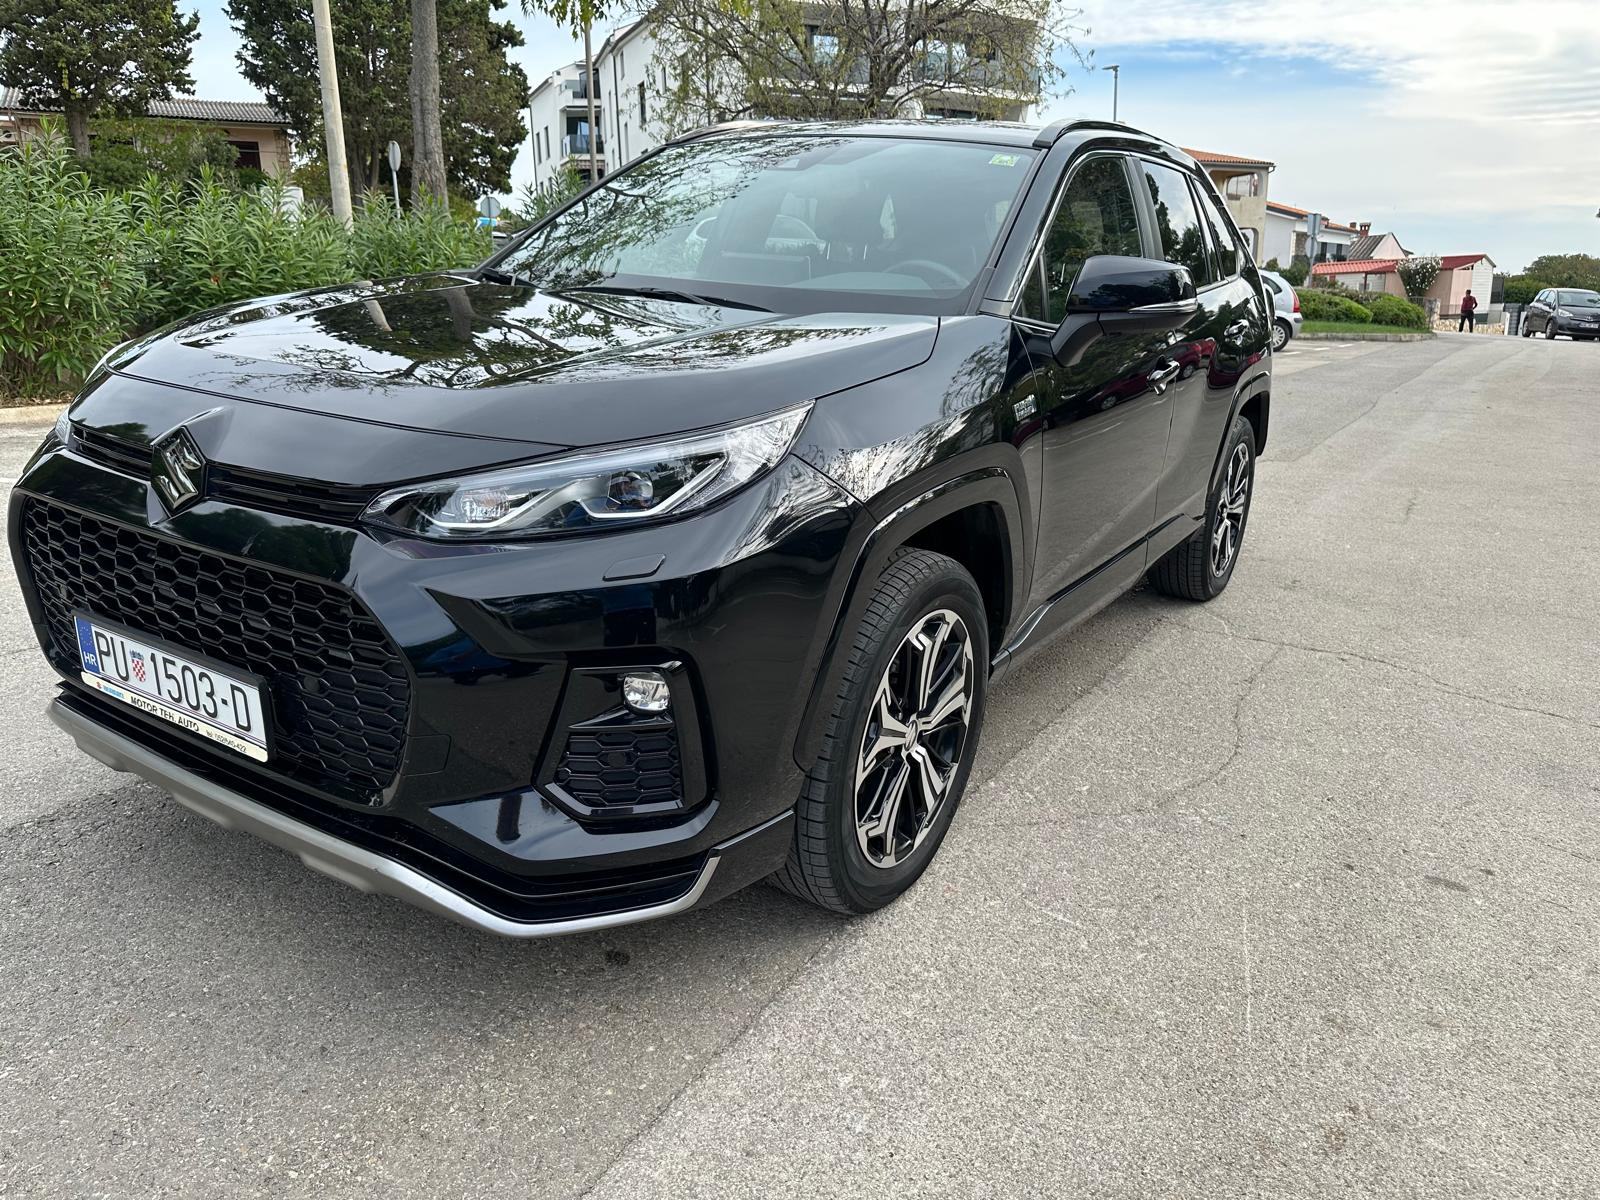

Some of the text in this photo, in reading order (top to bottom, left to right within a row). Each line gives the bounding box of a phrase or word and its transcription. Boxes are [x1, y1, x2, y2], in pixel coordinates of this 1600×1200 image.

[83, 651, 97, 666] HR
[94, 630, 252, 732] PU 1503-D
[130, 696, 158, 714] MOTOR
[178, 716, 199, 731] AUTO
